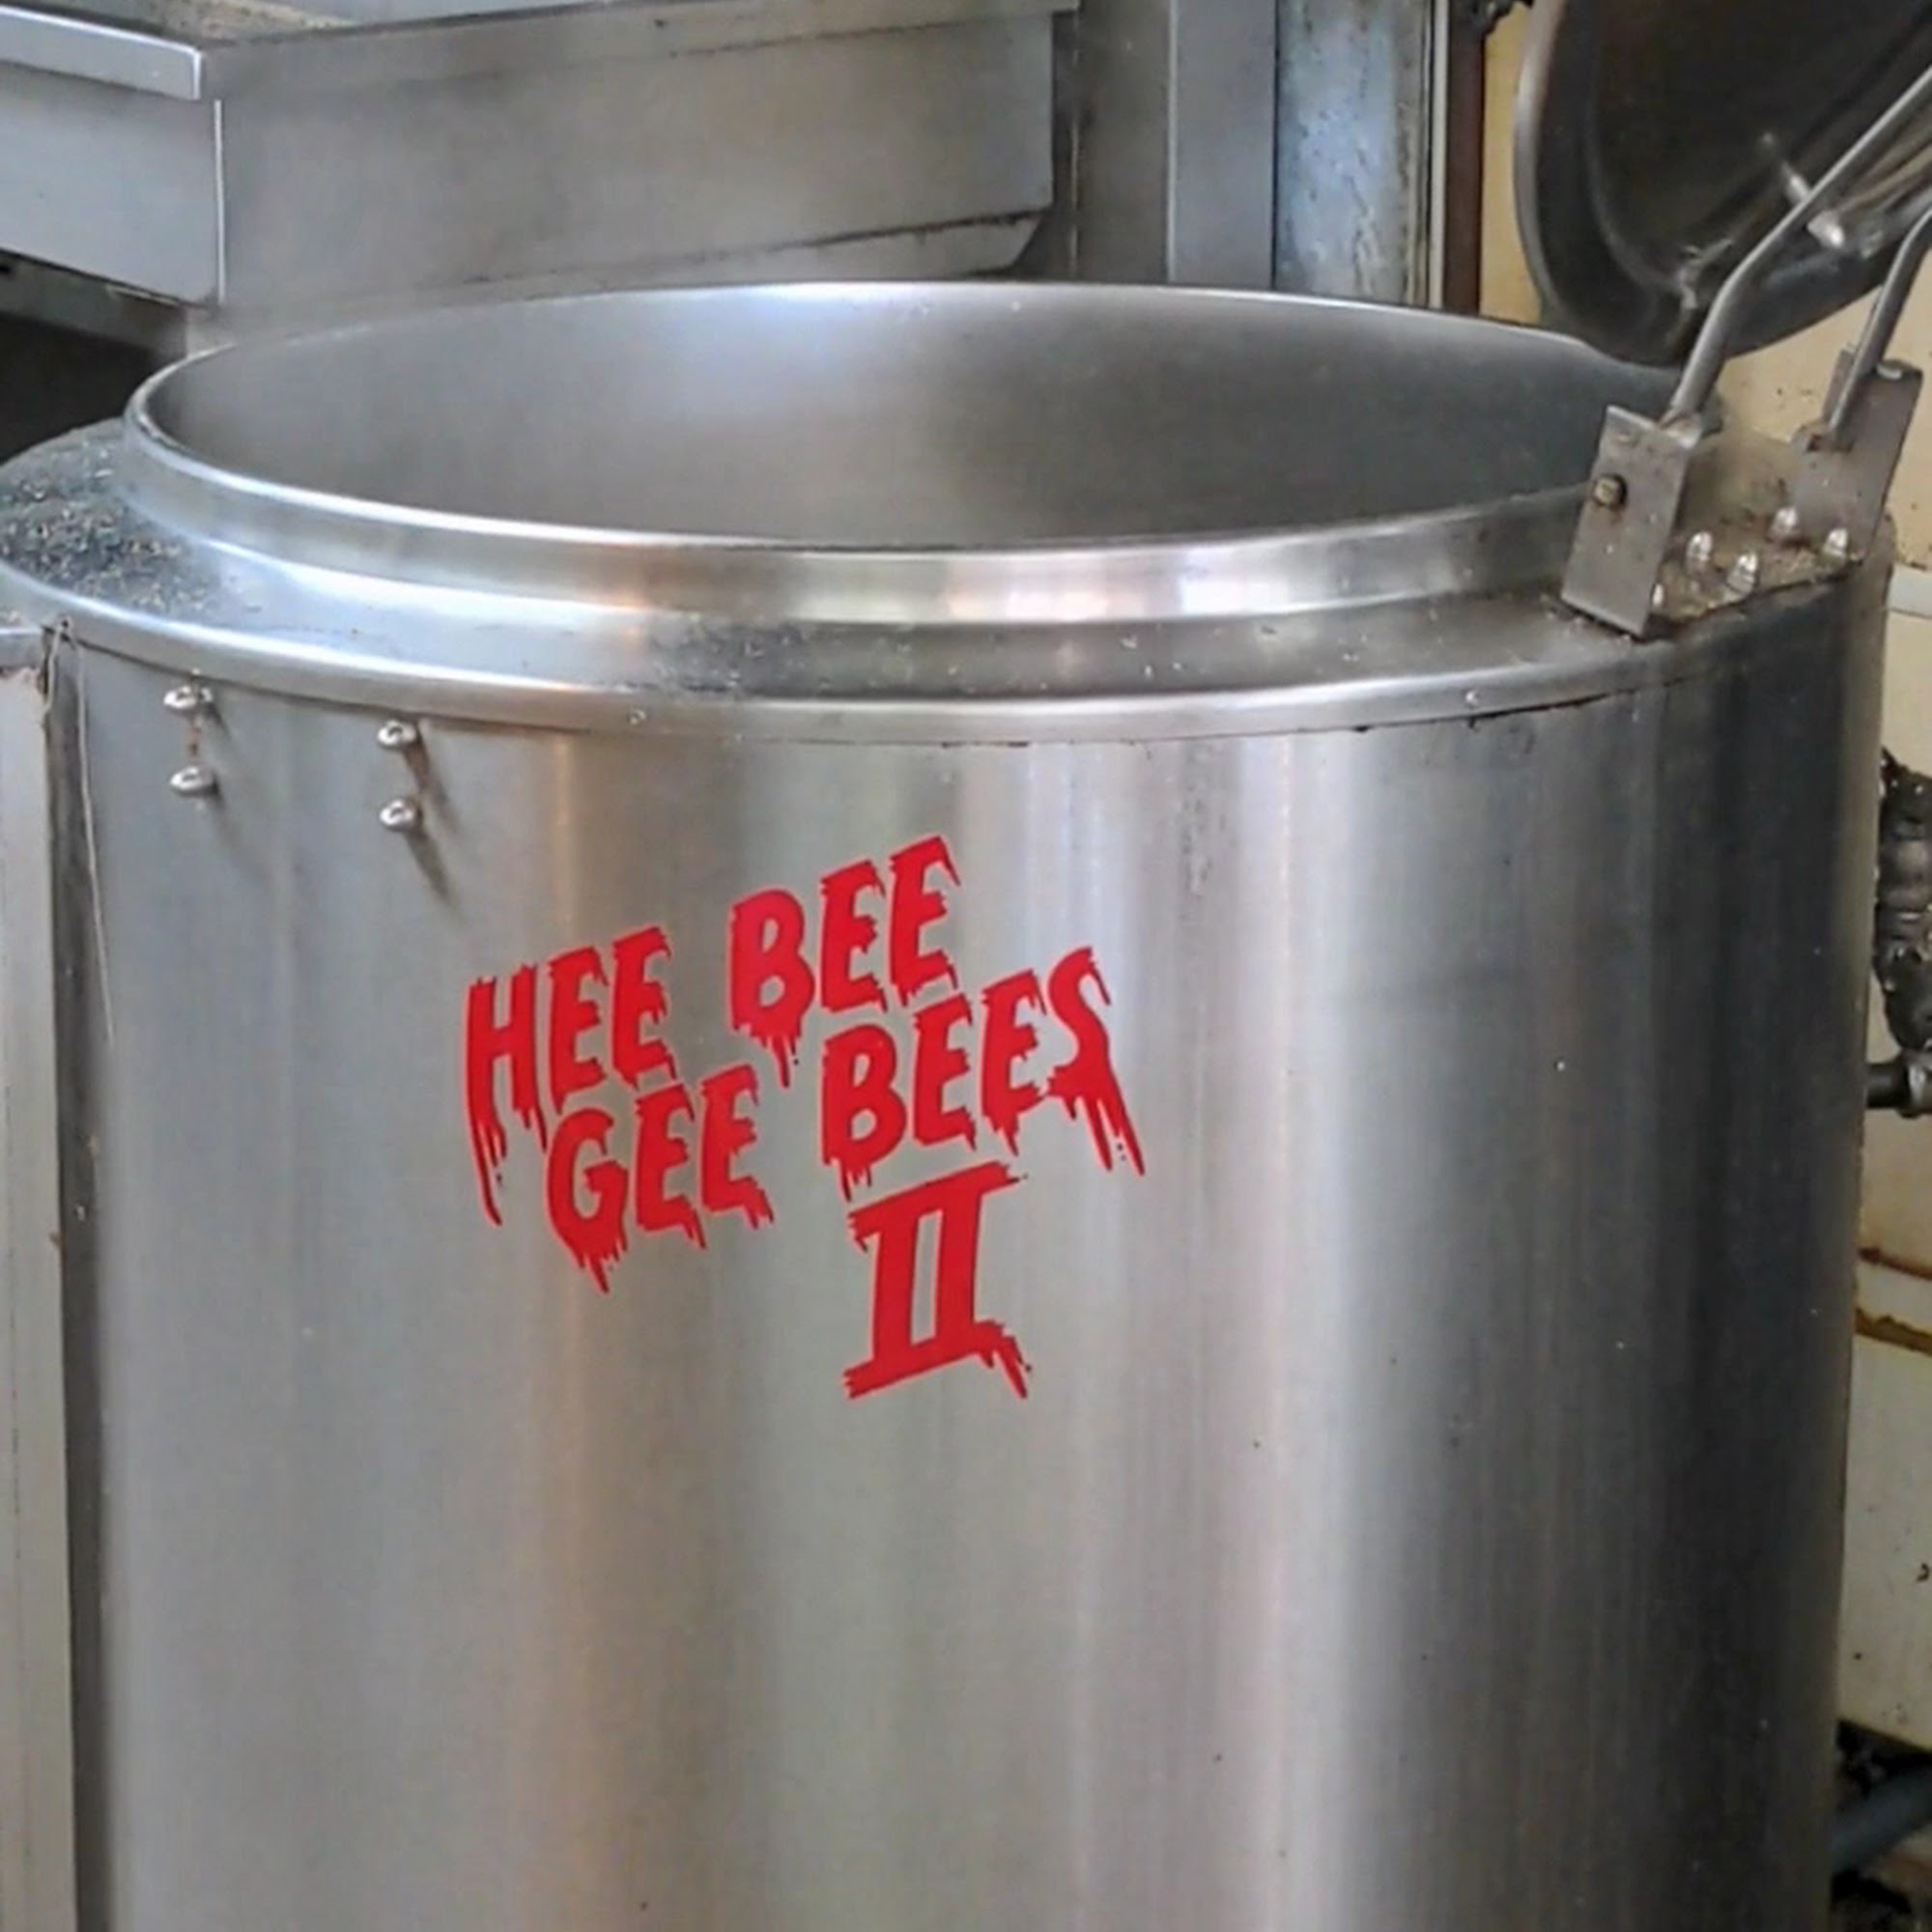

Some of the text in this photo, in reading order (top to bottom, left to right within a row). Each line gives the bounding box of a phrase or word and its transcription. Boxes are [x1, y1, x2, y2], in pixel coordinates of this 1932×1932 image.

[465, 835, 960, 1226] HEE BEE
[547, 947, 1145, 1293] GEE BEES
[843, 1160, 1031, 1399] II
